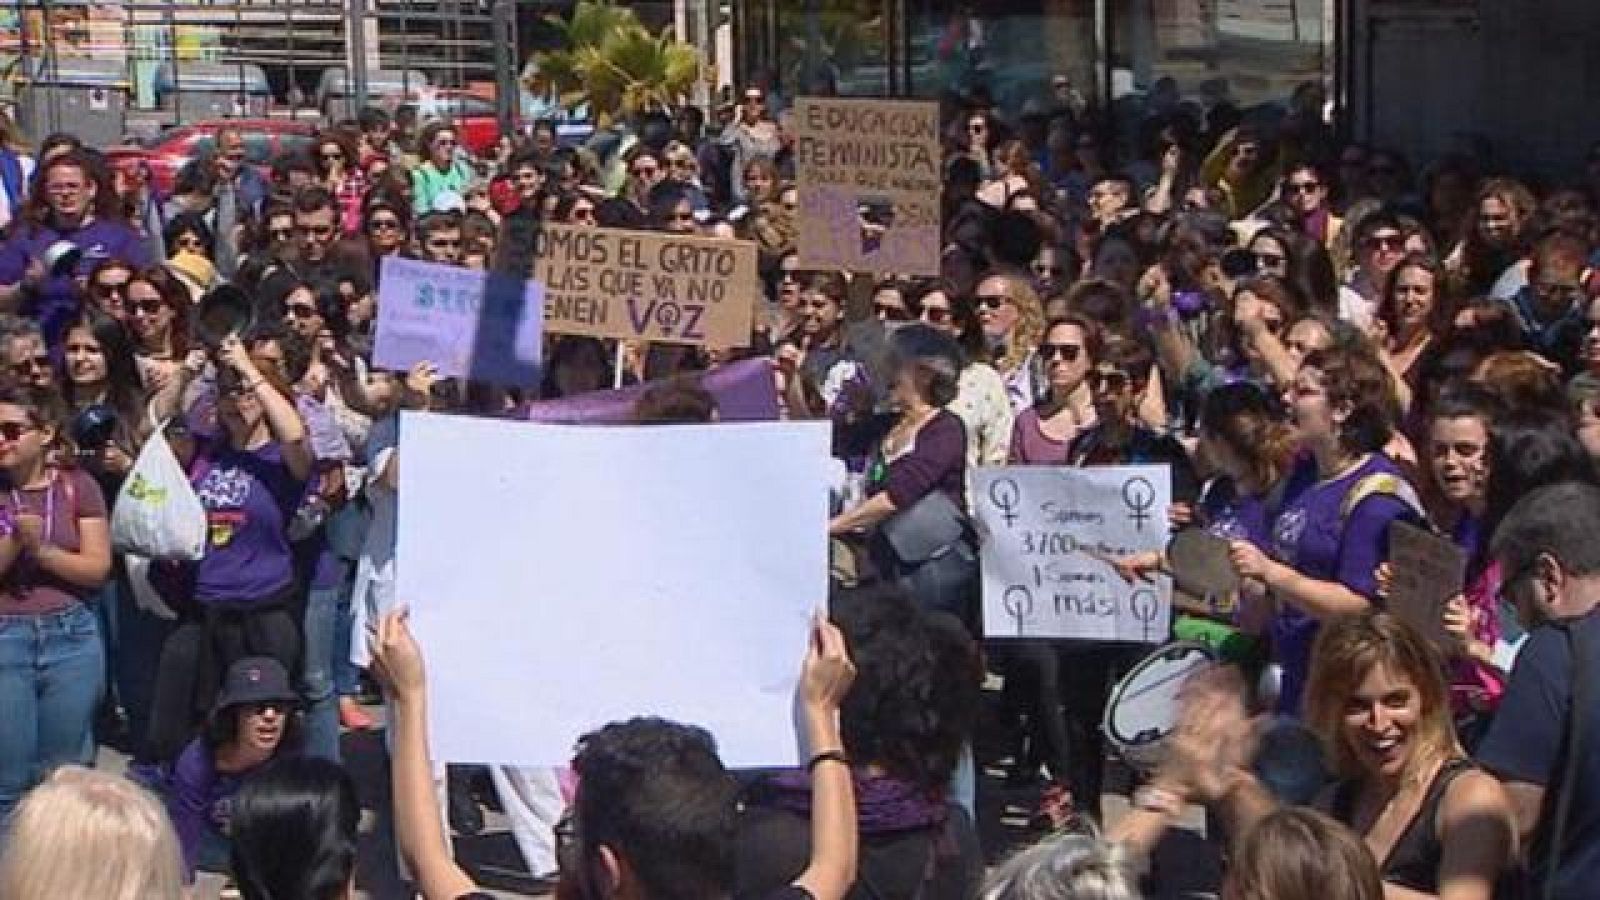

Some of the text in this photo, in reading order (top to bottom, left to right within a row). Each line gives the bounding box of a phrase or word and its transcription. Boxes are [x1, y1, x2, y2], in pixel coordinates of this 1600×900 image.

[799, 137, 936, 174] FEMINISTA
[534, 228, 736, 277] OMOS EL GRITO
[546, 265, 726, 303] LAS QUE YA NO
[544, 294, 706, 341] ENEN VOZ
